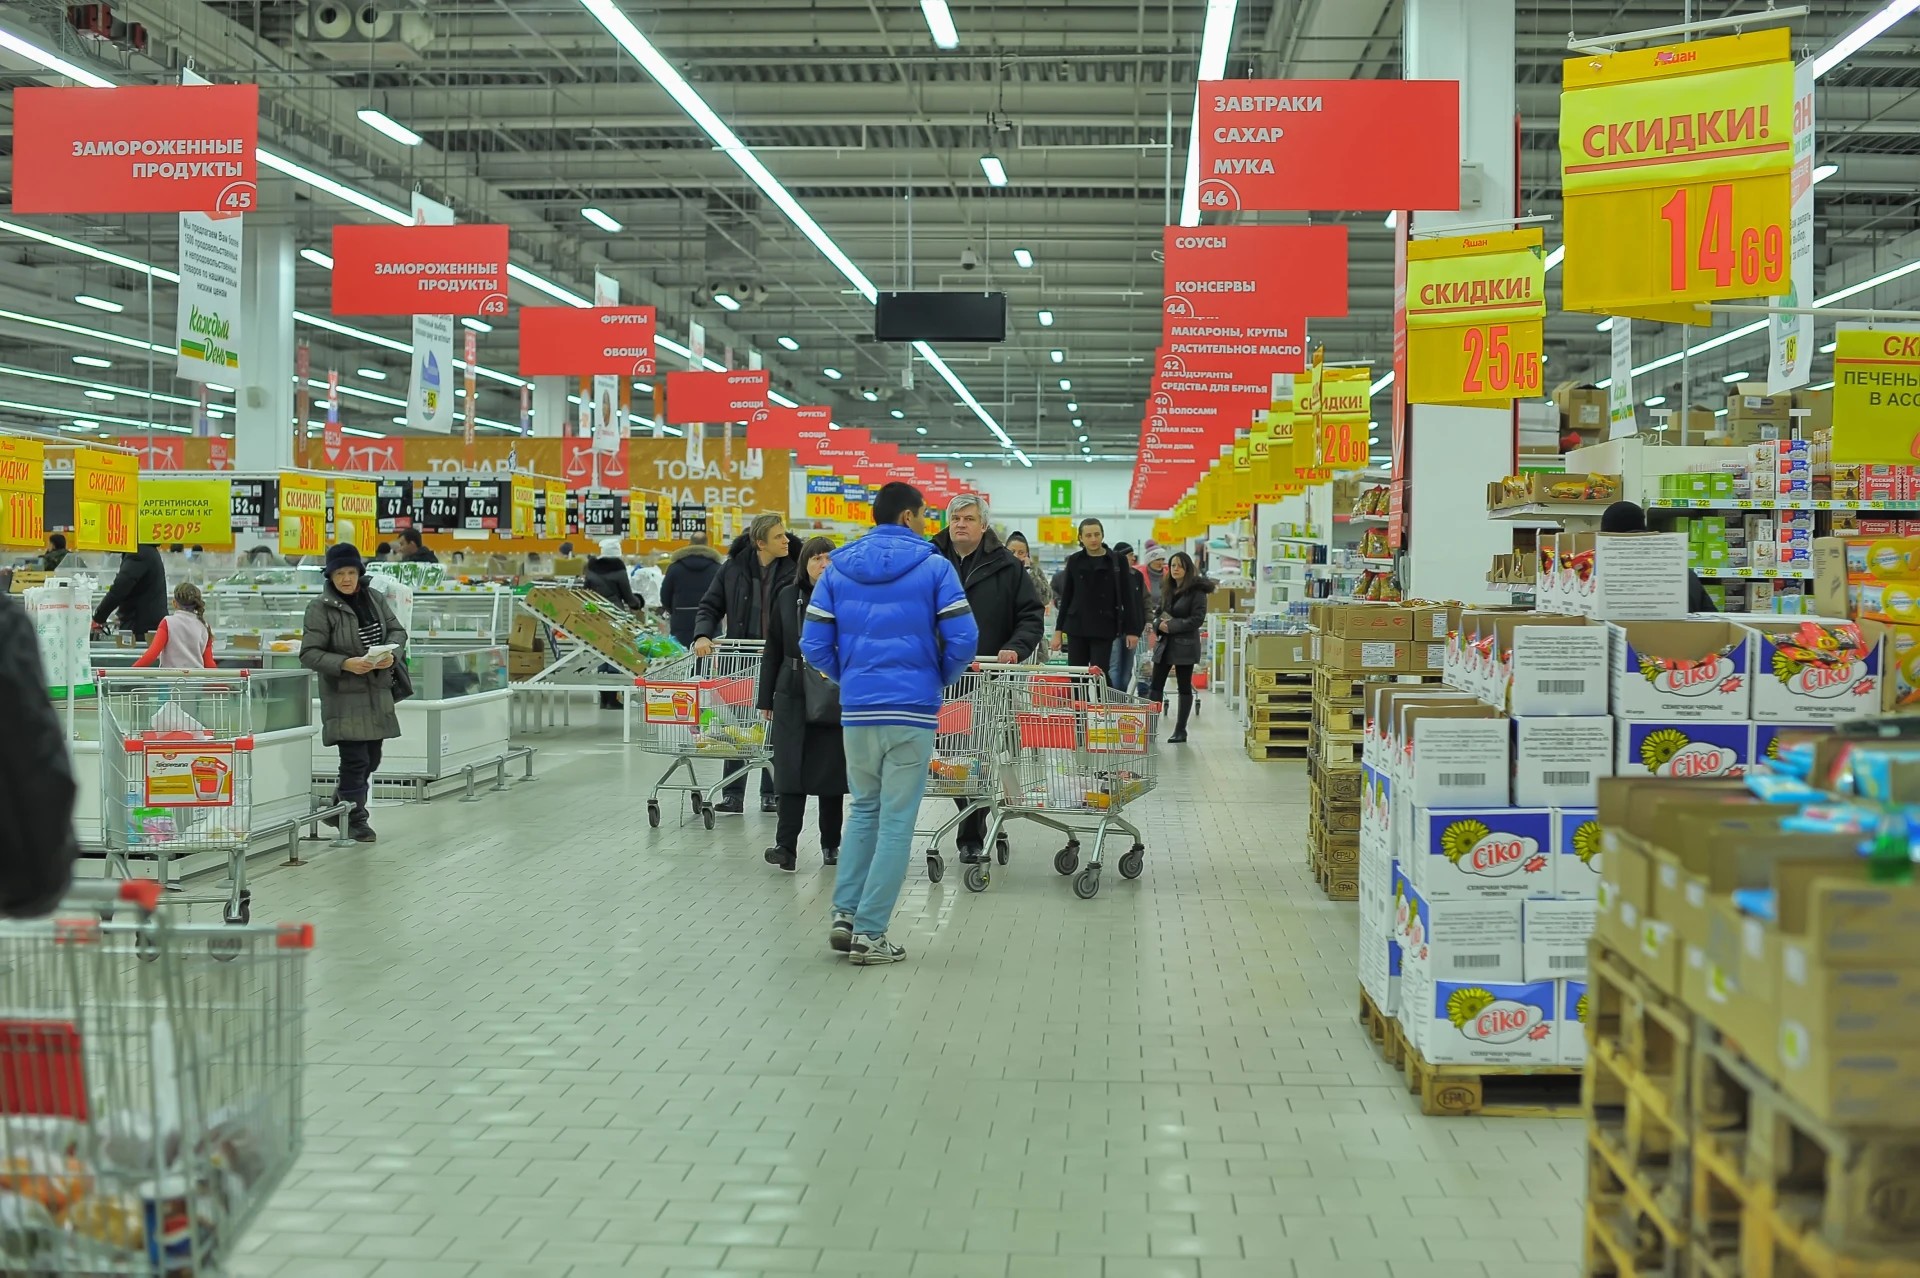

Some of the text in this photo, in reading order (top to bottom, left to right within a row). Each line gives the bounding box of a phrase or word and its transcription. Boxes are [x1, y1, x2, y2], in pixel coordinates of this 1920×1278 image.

[1214, 96, 1323, 112] ЗАВТРАКИ
[1213, 128, 1284, 143] САХАР
[1583, 105, 1769, 158] СКИДКИ!
[72, 139, 243, 157] ЗАМОРОЖЕННЫЕ
[132, 161, 243, 180] ПРОДУКТЫ
[1213, 159, 1275, 174] МУКА
[225, 192, 251, 208] 45
[1201, 190, 1229, 206] 46
[192, 222, 217, 241] предлагаем
[218, 230, 228, 243] Вам
[1661, 184, 1783, 291] 14 69
[184, 233, 238, 261] 1500 продовольственных
[1175, 237, 1227, 249] СОУСЫ
[1463, 239, 1488, 248] Ашан
[183, 262, 201, 277] товаров
[208, 271, 224, 284] нашим
[374, 263, 498, 275] ЗАМОРОЖЕННЫЕ
[213, 285, 227, 298] ценам
[418, 279, 498, 292] ПРОДУКТЫ
[1175, 281, 1256, 293] КОНСЕРВЫ
[1421, 277, 1531, 305] СКИДКИ!
[485, 302, 504, 313] 43
[1166, 304, 1186, 315] 44
[189, 304, 230, 340] Каждый
[601, 315, 648, 325] ФРУКТЫ
[1171, 327, 1287, 338] МАКАРОНЫ, КРУПЫ
[204, 337, 226, 366] День
[603, 348, 648, 358] ОВОЩИ
[1171, 344, 1302, 355] РАСТИТЕЛЬНОЕ МАСЛО
[1164, 361, 1179, 370] 42
[1463, 325, 1538, 392] 25 45
[638, 365, 652, 373] 41
[728, 376, 763, 384] ФРУКТЫ
[1161, 382, 1267, 393] СРЕДСТВА ДЛЯ БРИТЬЯ
[730, 401, 763, 409] ОВОЩИ
[1155, 397, 1168, 405] 40
[1870, 392, 1881, 405] В
[756, 413, 768, 421] 39
[1324, 425, 1366, 463] 28 90
[89, 472, 125, 495] СКИДКИ
[286, 491, 321, 510] СКИДКИ!
[342, 495, 373, 514] СКИДКИ!
[704, 487, 755, 507] ВЕС
[231, 498, 249, 514] 152
[388, 499, 401, 515] 67
[431, 499, 456, 515] 67 00
[471, 499, 498, 516] 47 00
[815, 496, 835, 515] 316
[11, 494, 33, 539] 111
[107, 504, 121, 544] 99
[586, 509, 602, 523] 561
[152, 522, 201, 541] 530 95
[682, 519, 696, 530] 153
[1668, 660, 1718, 690] Ciko
[1802, 664, 1850, 691] Ciko
[1671, 750, 1720, 777] Ciko
[1473, 840, 1522, 871] Ciko
[1477, 1009, 1527, 1037] Ciko
